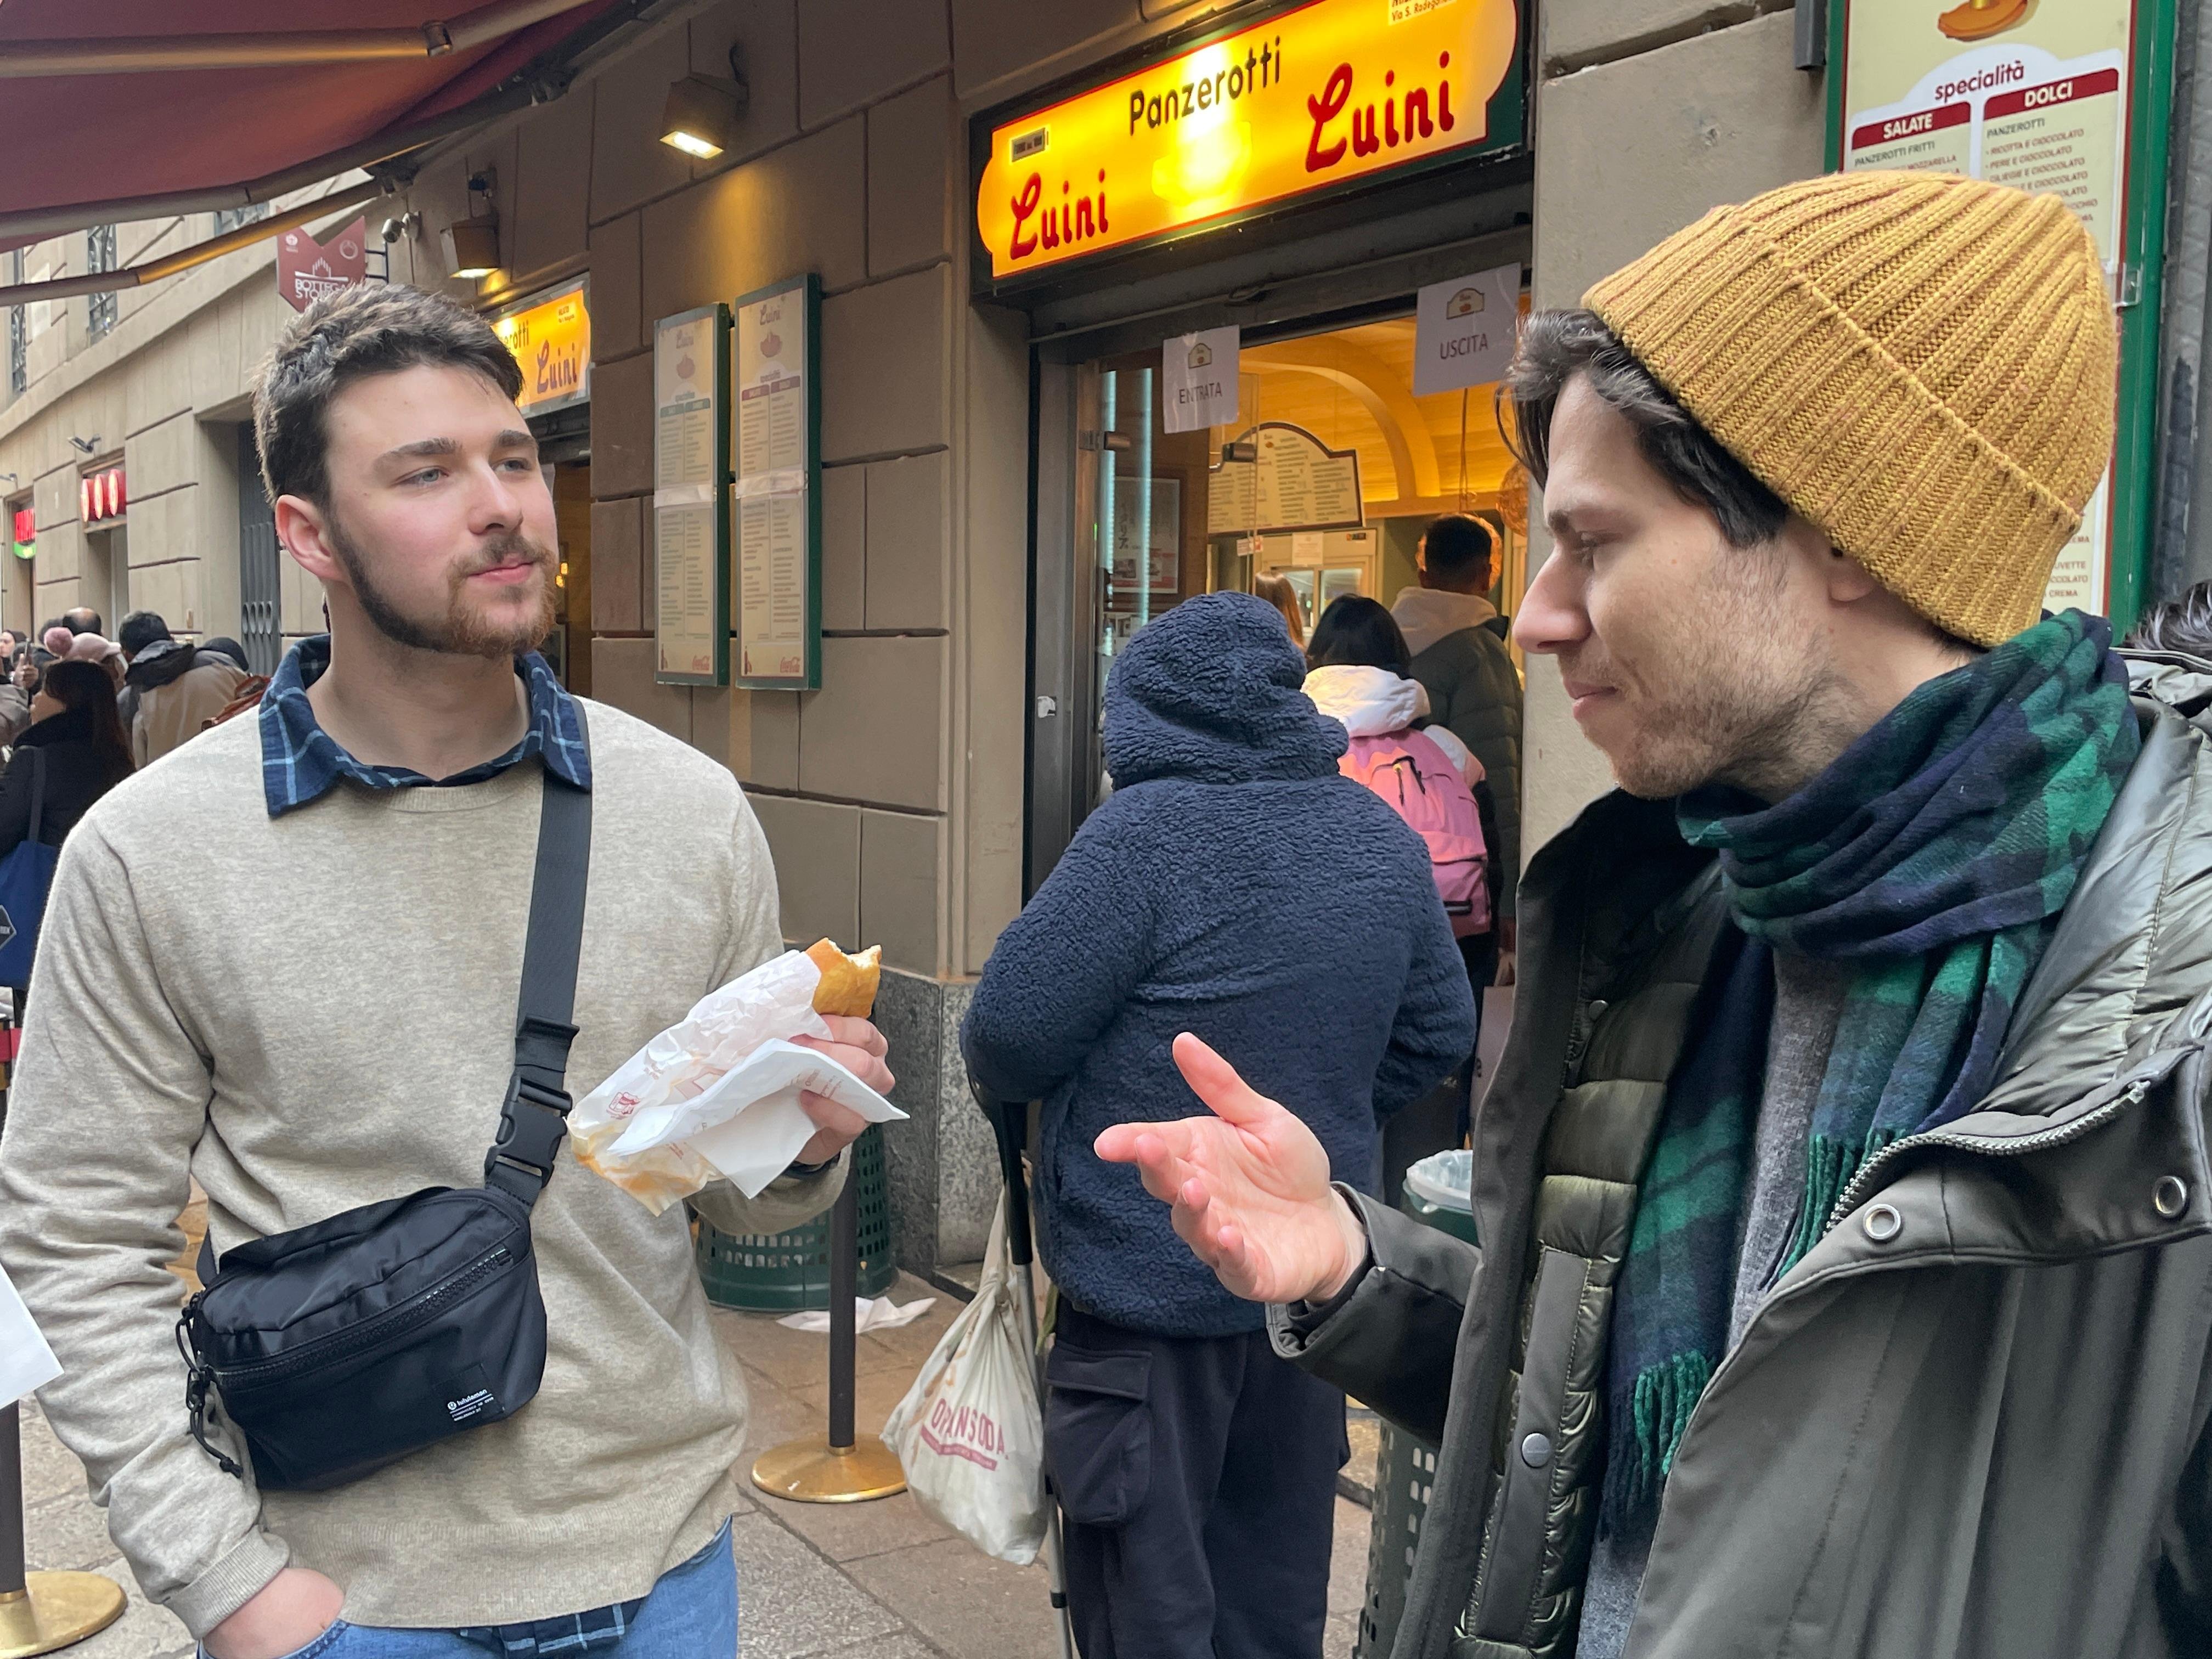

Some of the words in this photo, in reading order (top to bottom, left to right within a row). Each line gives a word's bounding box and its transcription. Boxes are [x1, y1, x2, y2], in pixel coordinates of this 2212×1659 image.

[1130, 35, 1280, 136] Panzerotti
[1934, 59, 2025, 103] specialità
[2024, 81, 2073, 108] DOLCI
[1306, 51, 1454, 173] Luini
[1883, 113, 1933, 139] SALATE
[1987, 117, 2046, 138] PANZEROTTI
[1854, 147, 1906, 167] PANZEROTTI
[1908, 140, 1936, 155] FRITTI
[1010, 168, 1109, 260] Luini
[1440, 333, 1489, 360] USCITA
[537, 339, 577, 394] Luini
[1178, 382, 1223, 404] ENTRATA
